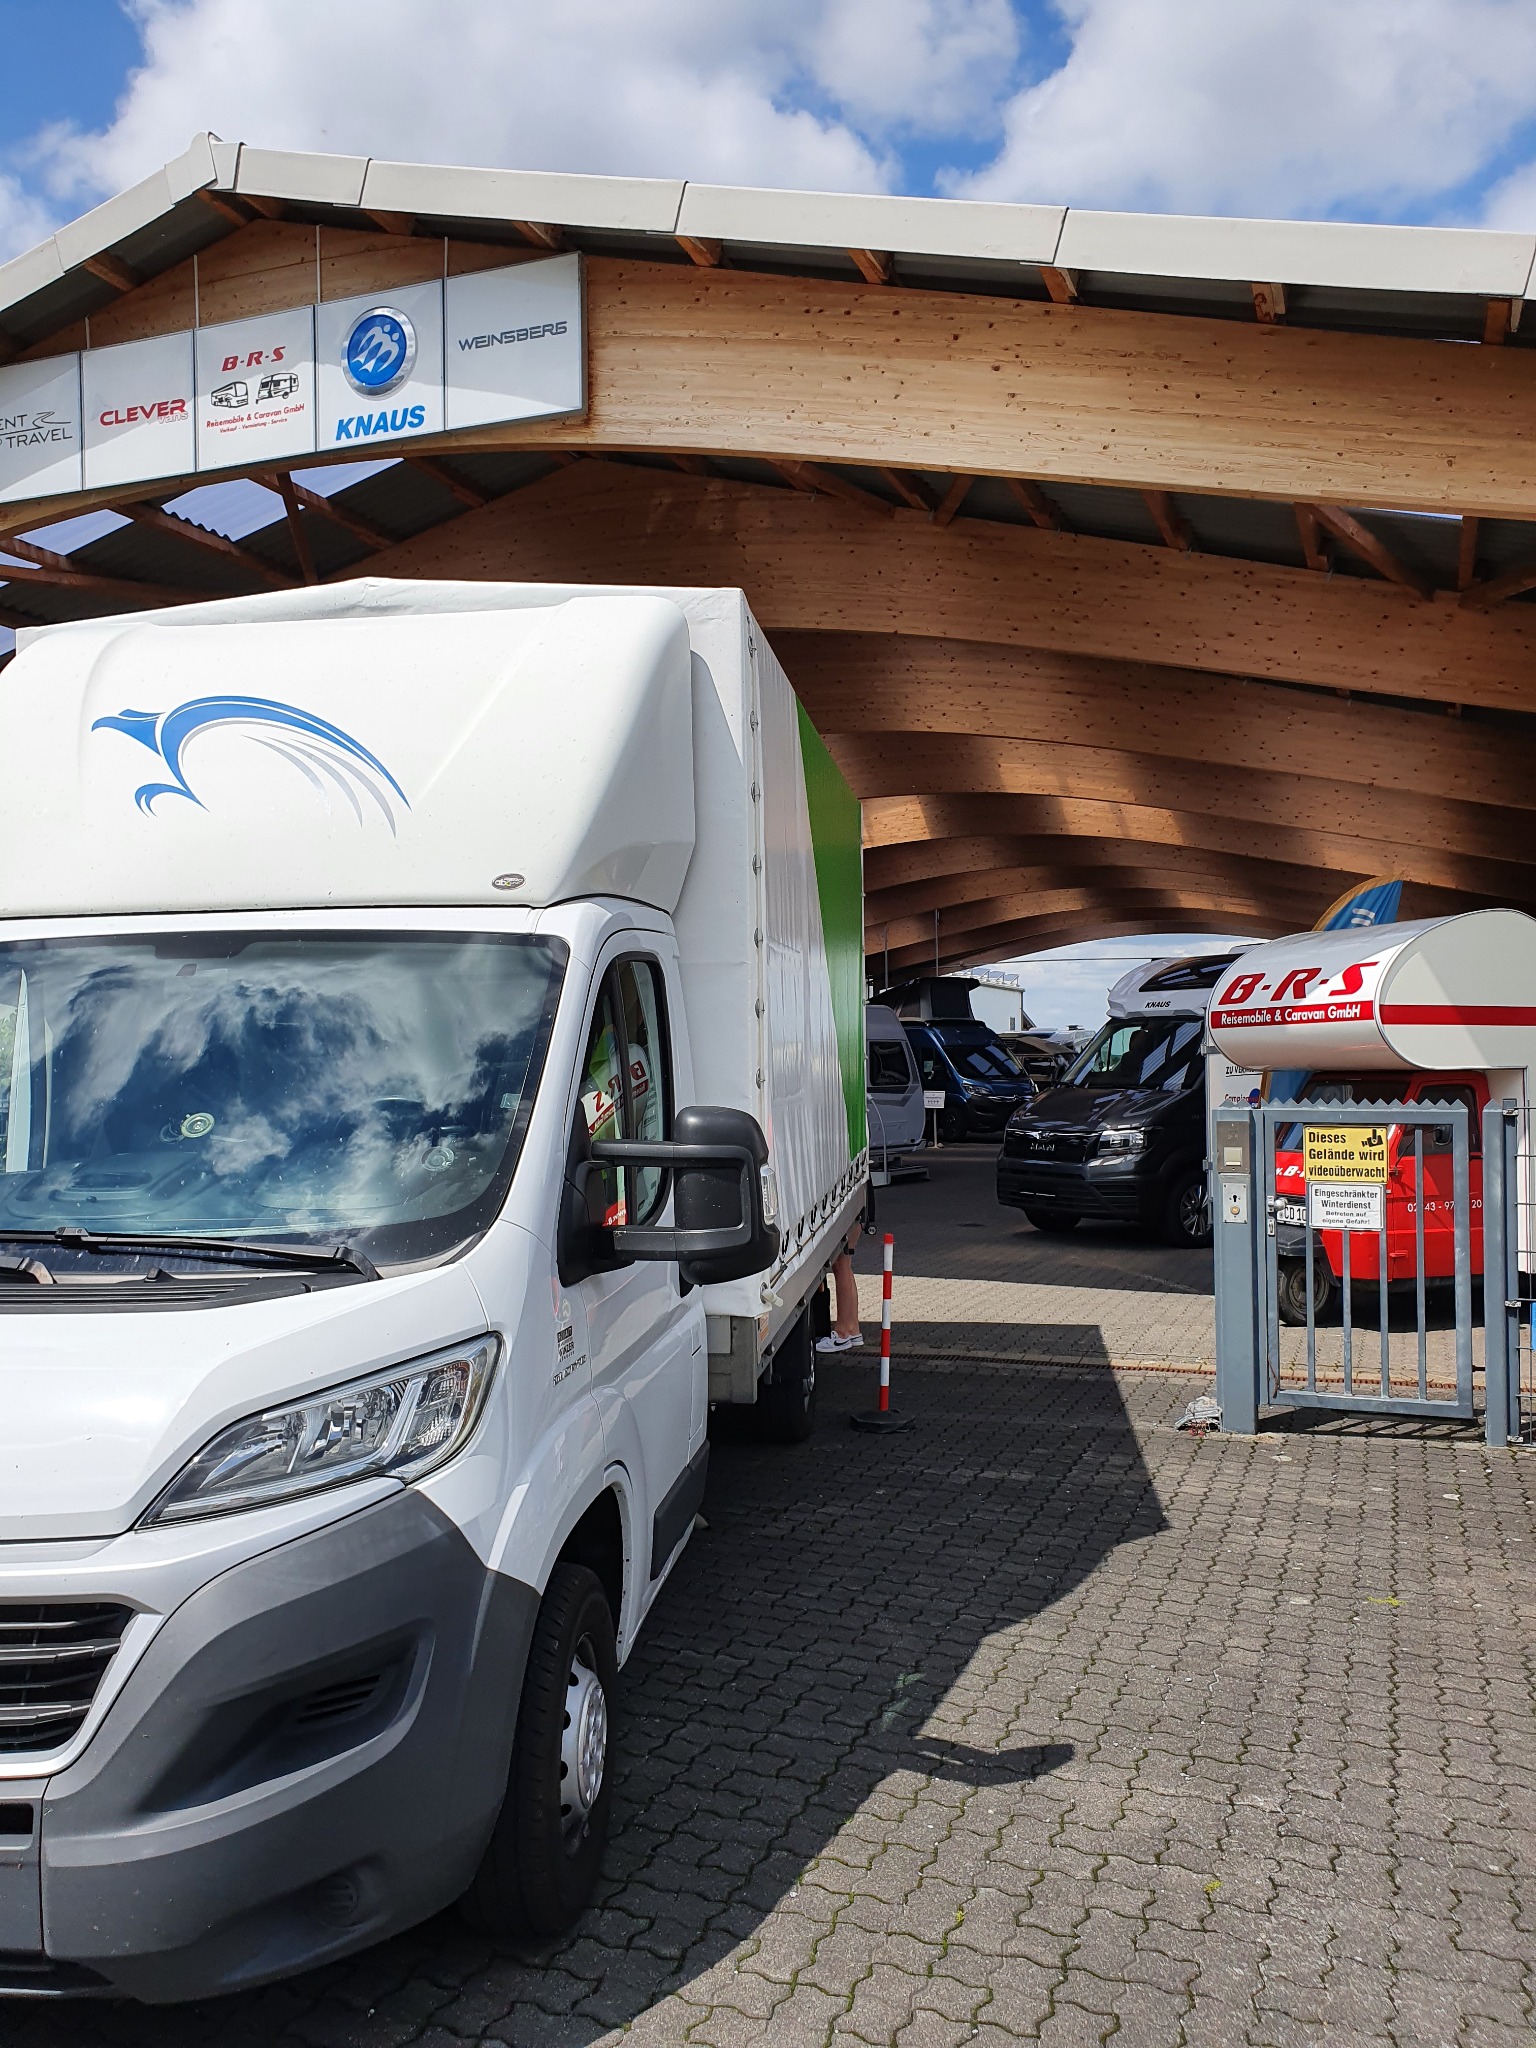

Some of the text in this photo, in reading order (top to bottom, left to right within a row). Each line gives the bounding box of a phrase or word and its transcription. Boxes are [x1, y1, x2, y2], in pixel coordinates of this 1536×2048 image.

[458, 321, 568, 351] WEINSBERG
[100, 399, 186, 426] CLEVER
[157, 410, 189, 424] vans
[206, 415, 245, 428] Reisemobile
[254, 410, 282, 420] Caravan
[283, 403, 305, 415] GmbH
[220, 425, 238, 433] Verkauf
[271, 417, 288, 425] Service
[335, 405, 426, 441] KNAUS
[5, 428, 72, 448] TRAVEL
[1144, 1000, 1171, 1008] KNAUS
[1221, 1003, 1361, 1025] Reisemobile & Caravan GmbH
[1308, 1132, 1346, 1143] Dieses
[1309, 1148, 1385, 1161] Gelände wird
[1308, 1165, 1385, 1178] videoüberwacht
[1314, 1188, 1378, 1199] Eingeschränkter
[1321, 1200, 1371, 1209] Winterdienst
